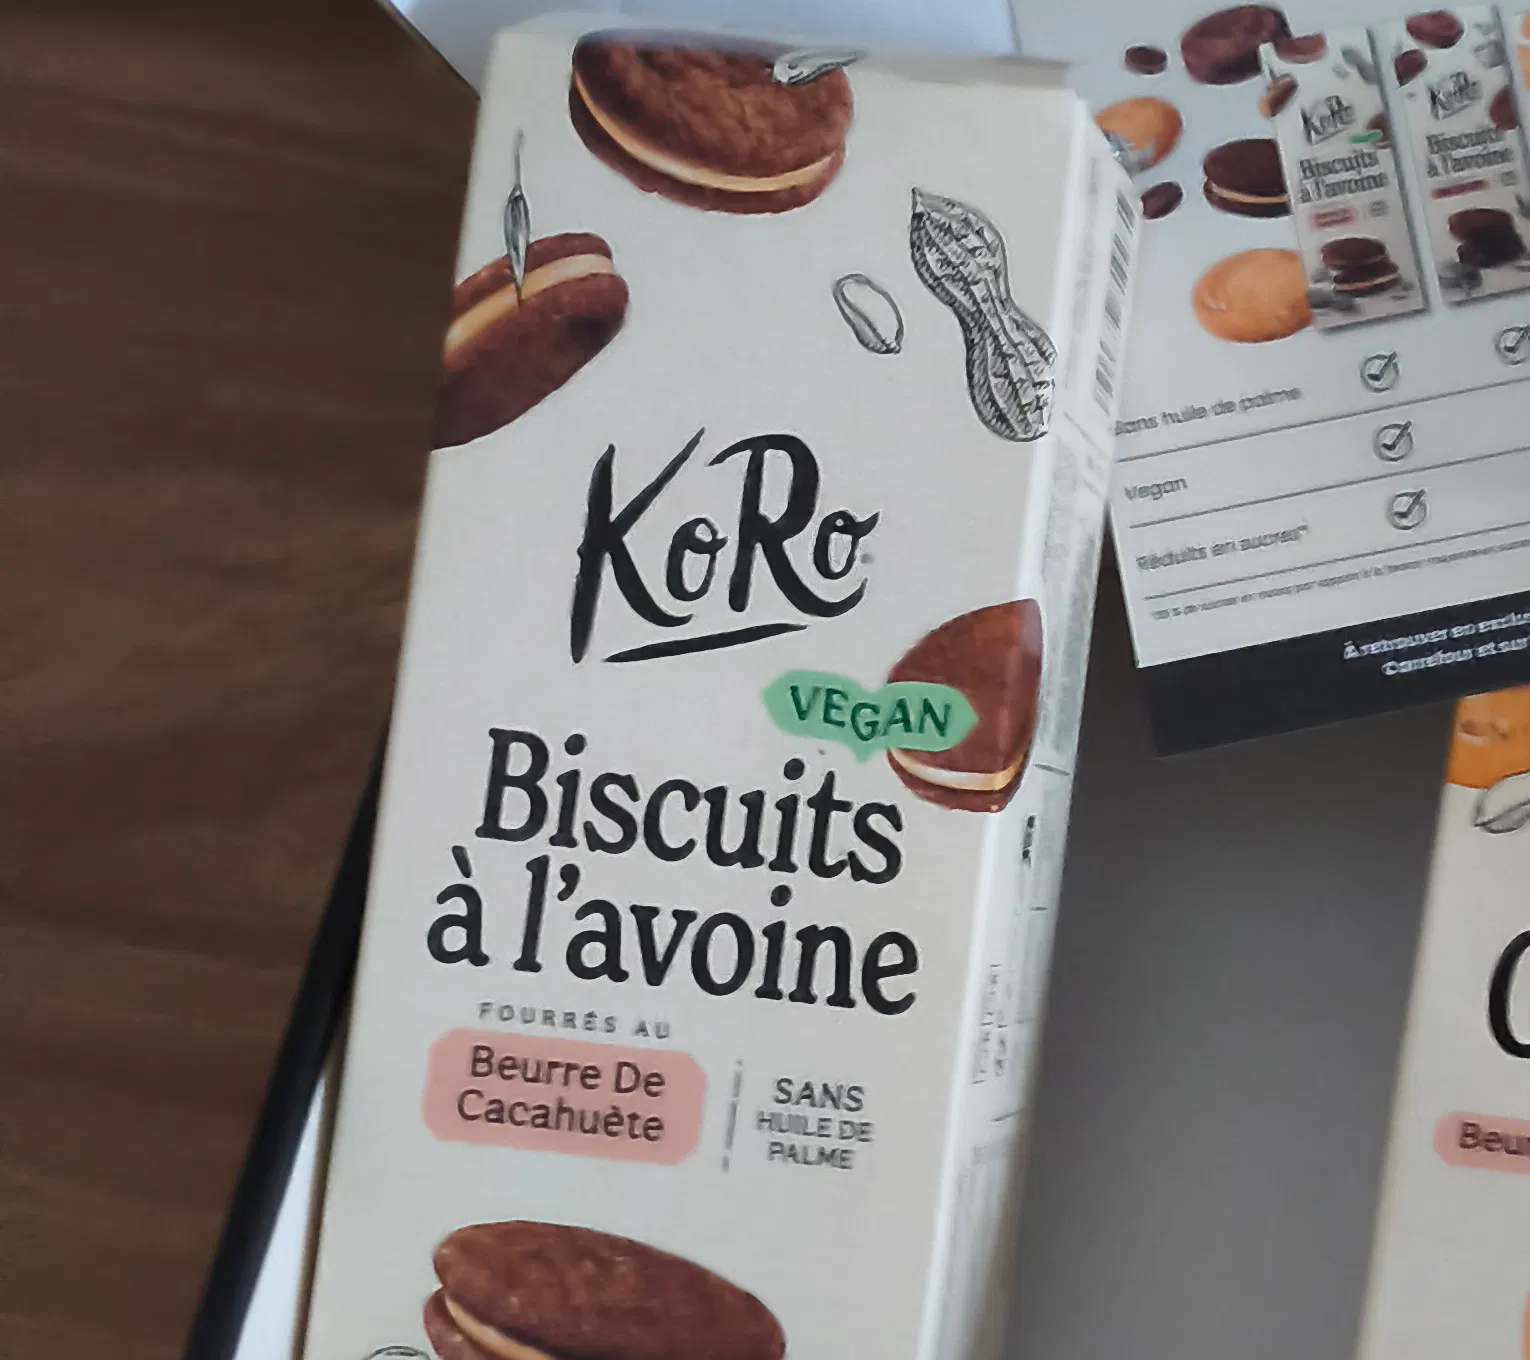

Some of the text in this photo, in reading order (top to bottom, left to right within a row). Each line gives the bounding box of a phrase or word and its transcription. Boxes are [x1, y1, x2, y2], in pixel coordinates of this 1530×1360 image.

[1124, 478, 1188, 502] Vegan
[570, 426, 881, 665] KoRo
[789, 685, 952, 740] VEGAN
[475, 727, 905, 884] Biscuits
[426, 846, 919, 1015] à l'avoine
[477, 1002, 671, 1039] FOURRÉS AU
[471, 1045, 666, 1098] Beurre De
[773, 1078, 865, 1113] SANS
[457, 1089, 664, 1142] Cacahuète
[757, 1111, 874, 1142] HUILE DE
[768, 1141, 855, 1170] PALME
